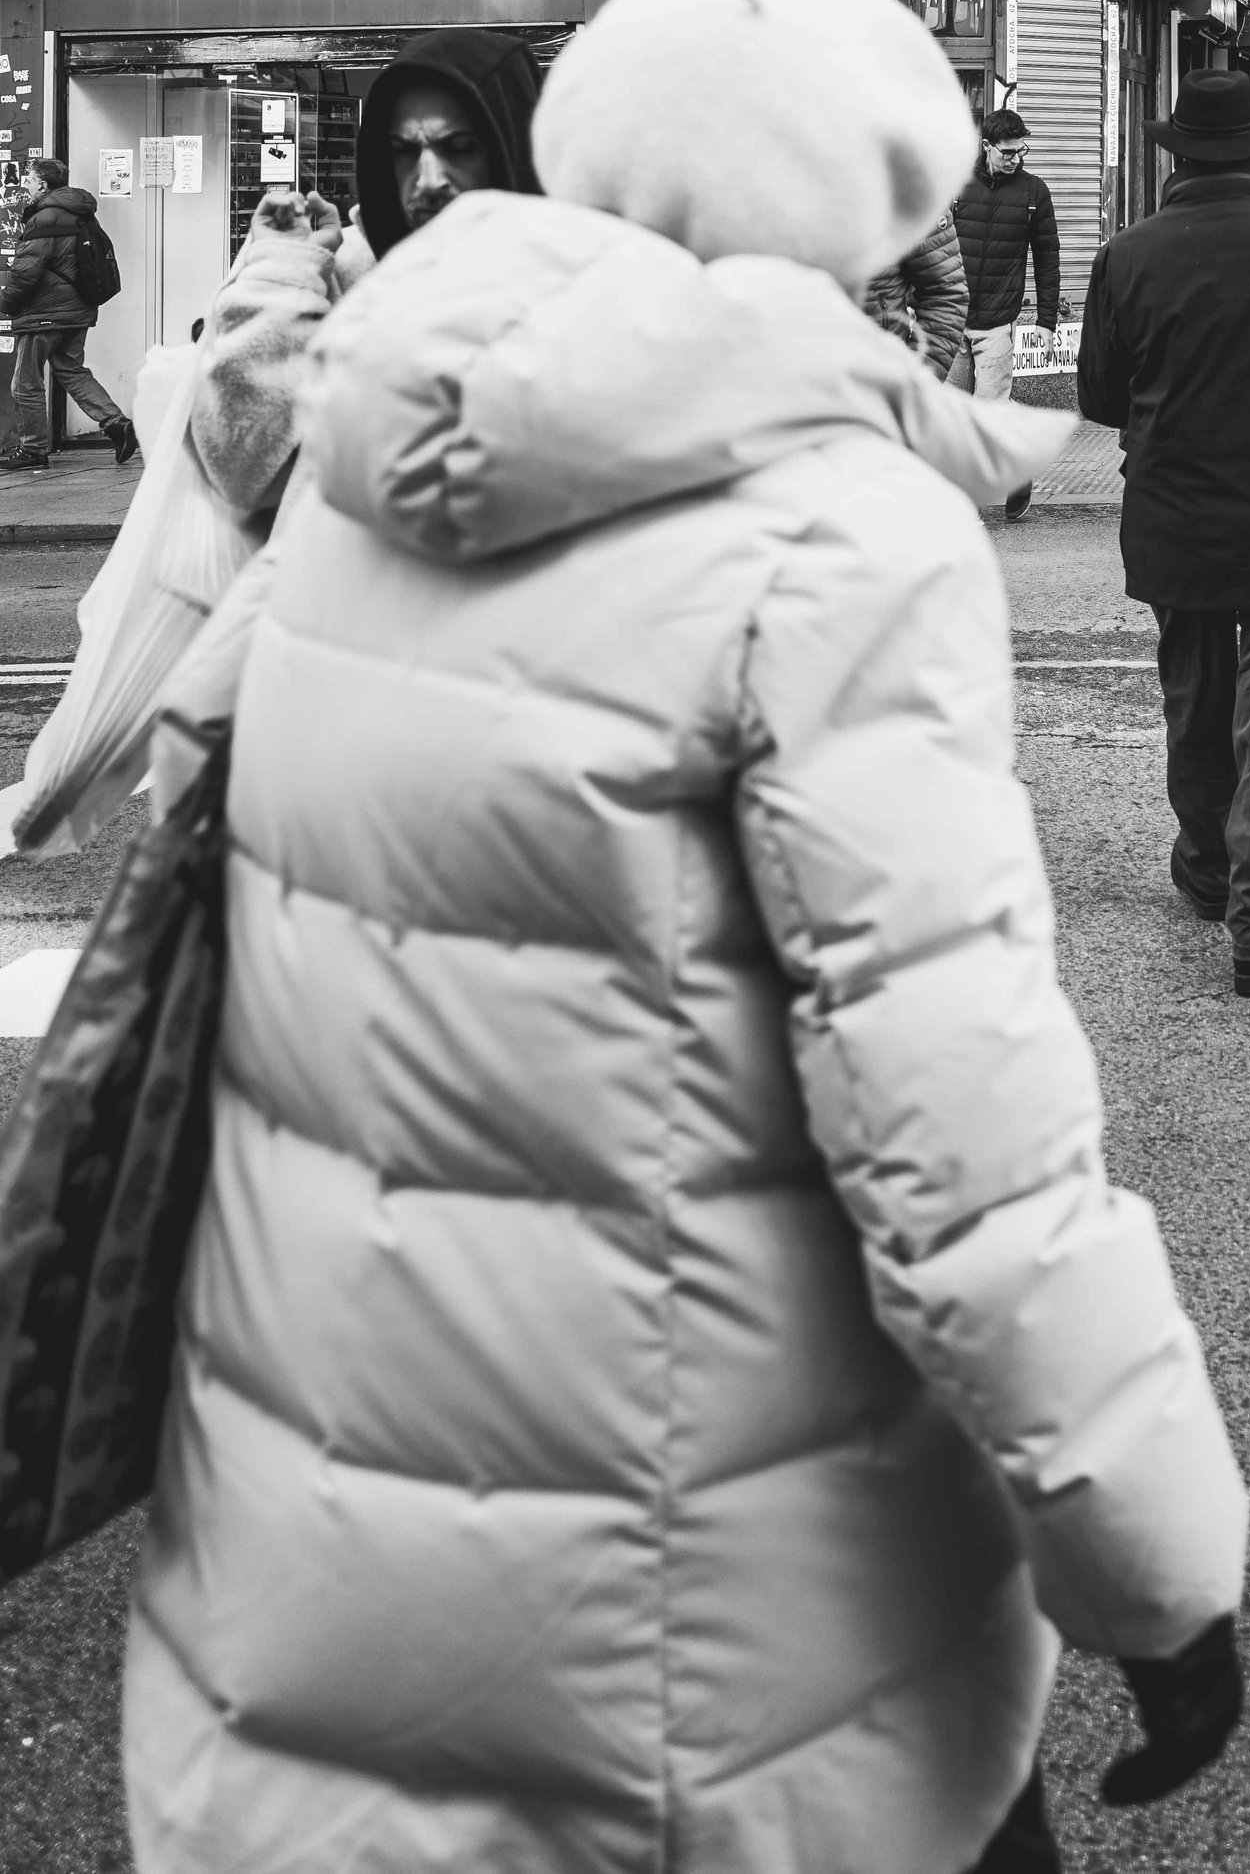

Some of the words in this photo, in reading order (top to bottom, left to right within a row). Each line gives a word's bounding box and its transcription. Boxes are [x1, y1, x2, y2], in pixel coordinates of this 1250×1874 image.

[1110, 70, 1118, 116] CUCHILLOS
[1110, 125, 1118, 162] NAVAJAS
[1022, 330, 1063, 349] MEJOS
[1053, 350, 1078, 367] NAVAJA
